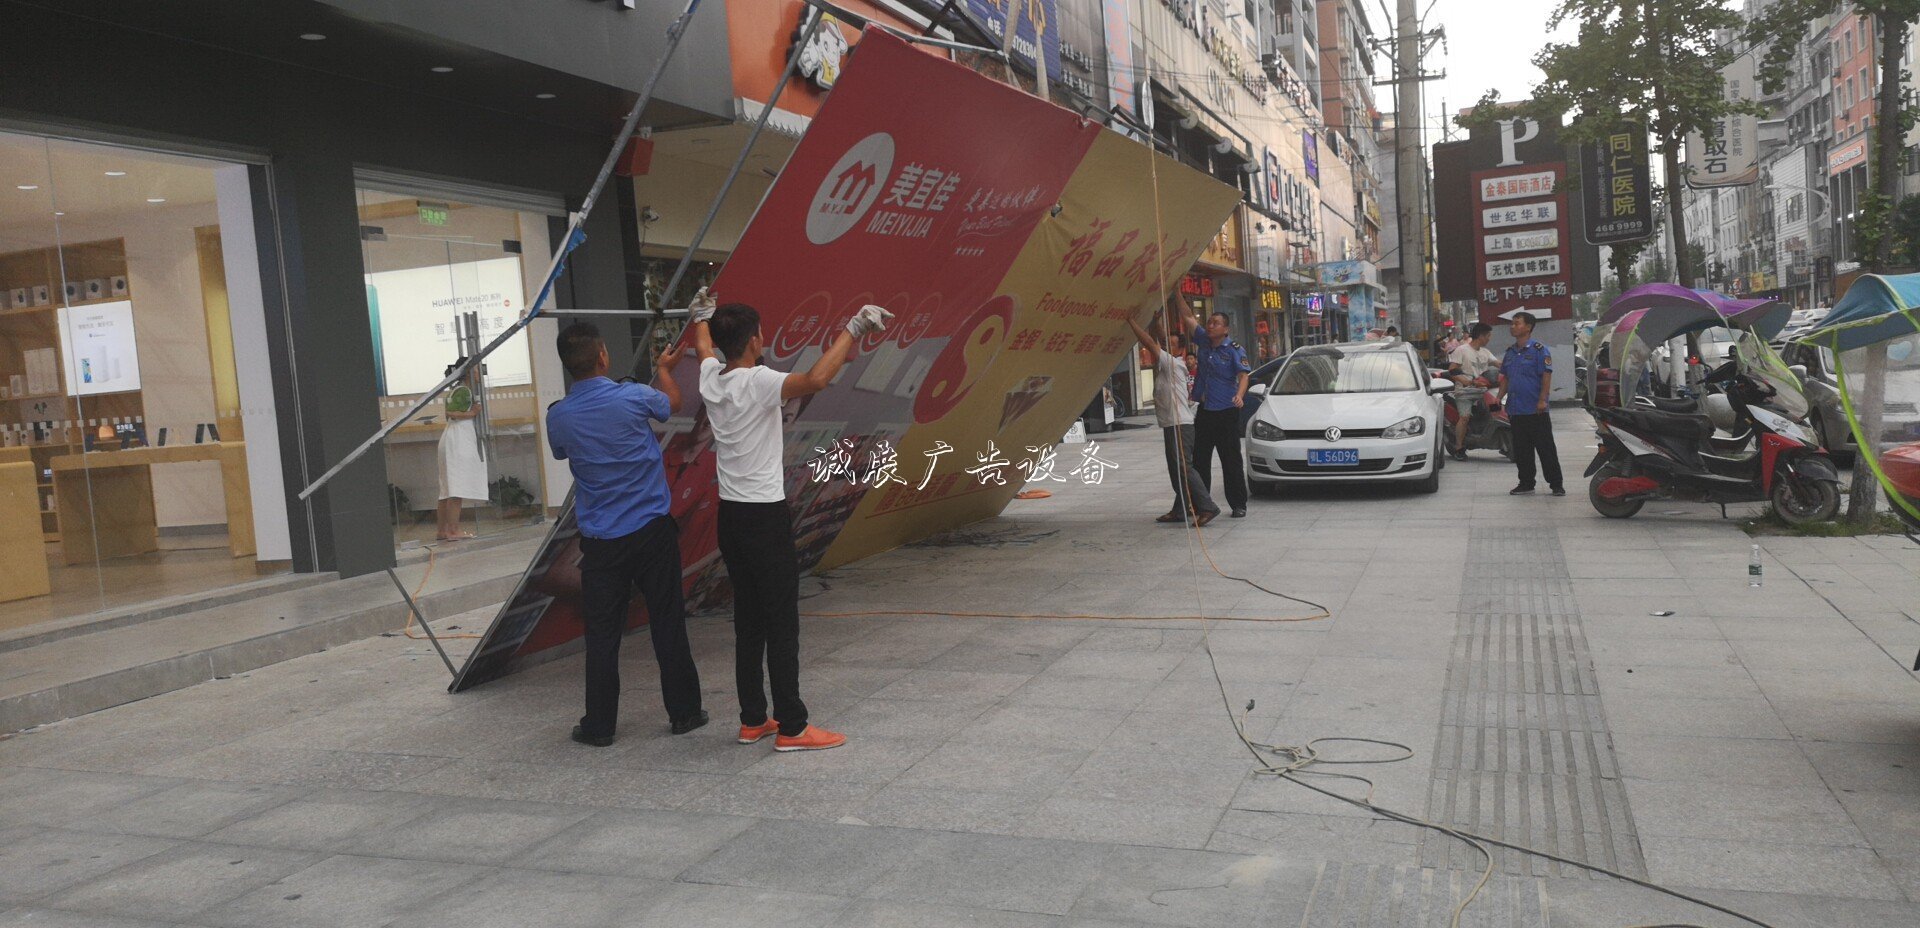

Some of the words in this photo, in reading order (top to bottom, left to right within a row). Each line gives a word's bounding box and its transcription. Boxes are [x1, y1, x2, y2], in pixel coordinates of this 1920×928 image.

[1495, 115, 1540, 168] P
[883, 161, 961, 212] 美宜佳
[1485, 175, 1552, 198] 金泰国际酒店
[1609, 132, 1636, 217] 同仁医院
[865, 210, 934, 239] MEIYIJIA
[1489, 206, 1550, 224] 世纪华联
[1492, 258, 1549, 277] 无忧咖啡馆
[1482, 281, 1568, 304] 地下停车场
